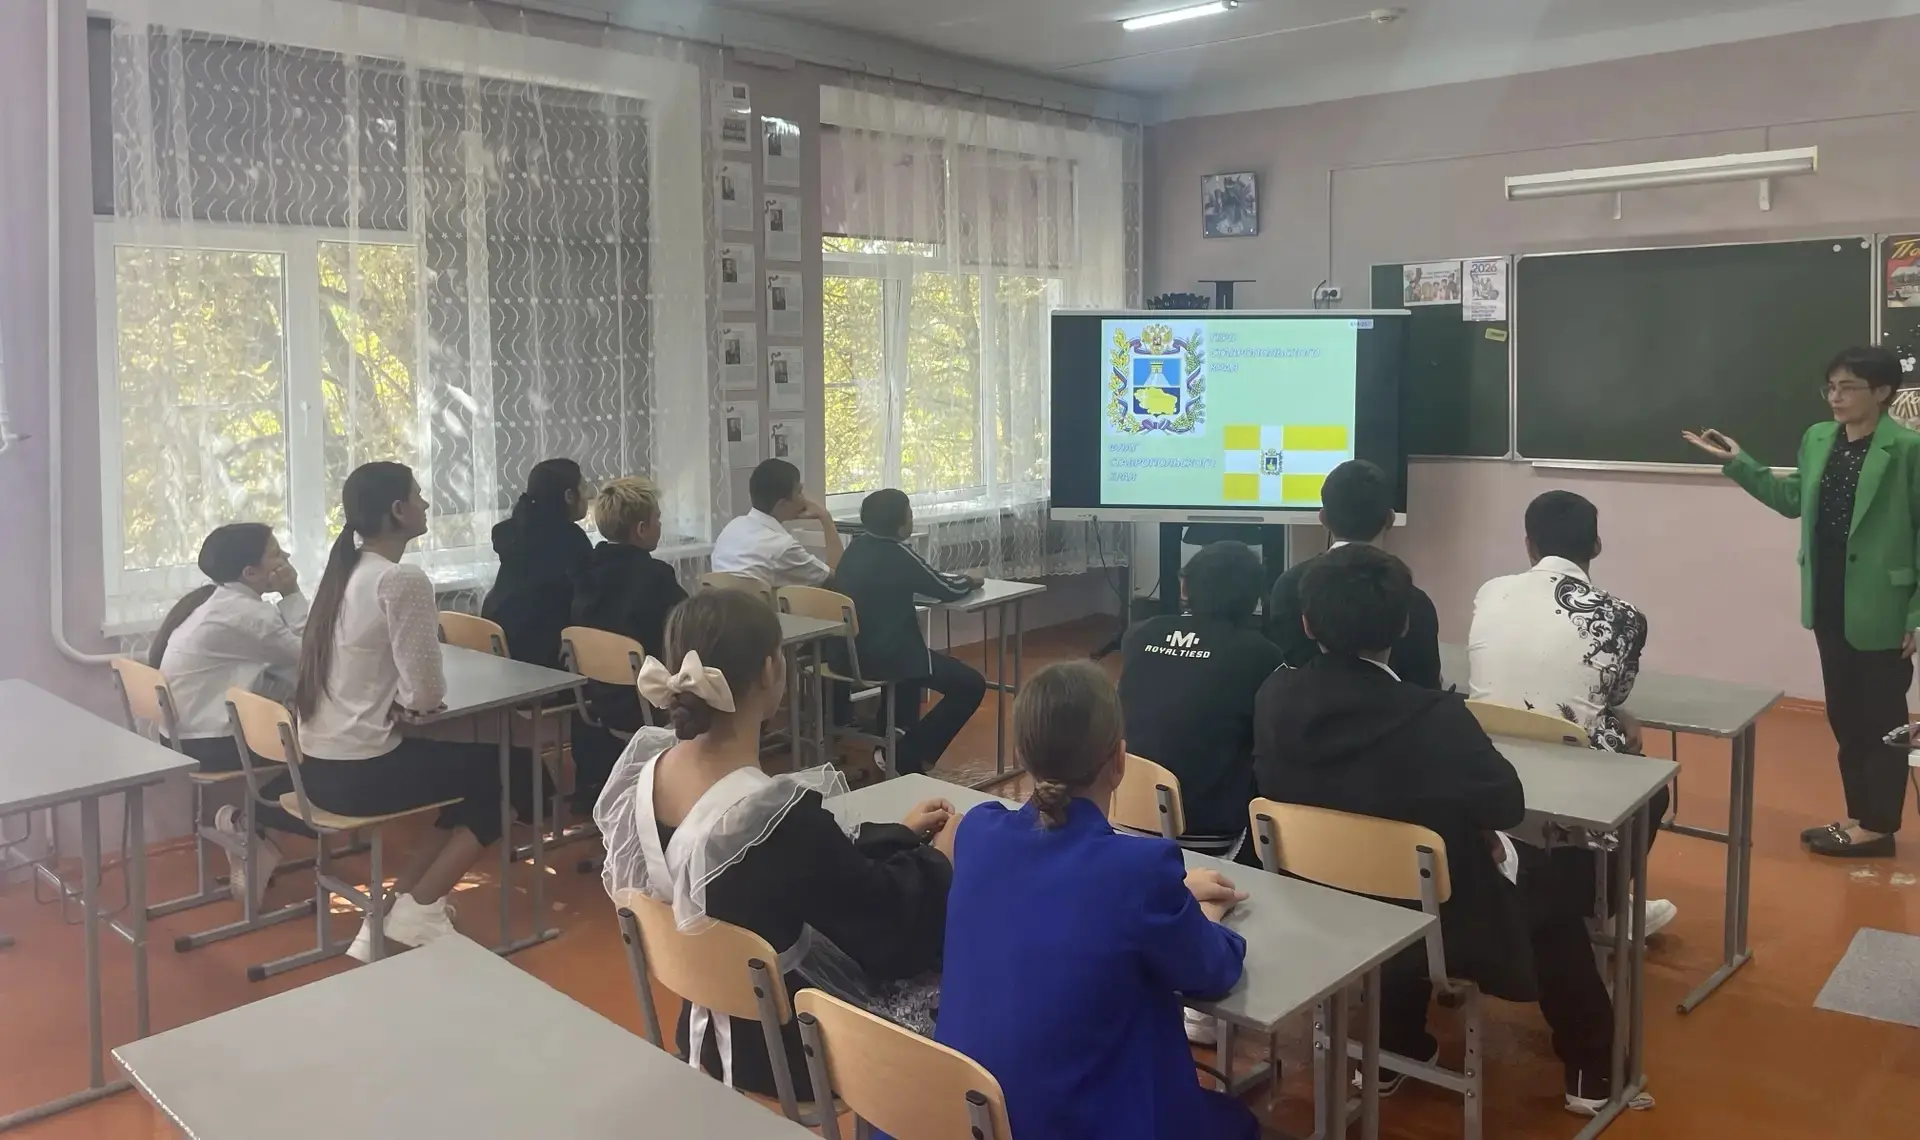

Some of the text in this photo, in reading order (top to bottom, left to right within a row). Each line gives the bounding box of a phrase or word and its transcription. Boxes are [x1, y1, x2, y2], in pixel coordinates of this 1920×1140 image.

[1472, 263, 1497, 273] 2026
[1209, 347, 1321, 359] СТАВРОПОЛЬСКОГО
[1209, 363, 1238, 373] КРАЯ
[1108, 442, 1139, 453] ФЛАГ
[1109, 456, 1217, 469] СТАВРОПОЛЬСКОГО
[1108, 471, 1138, 482] КРАЯ
